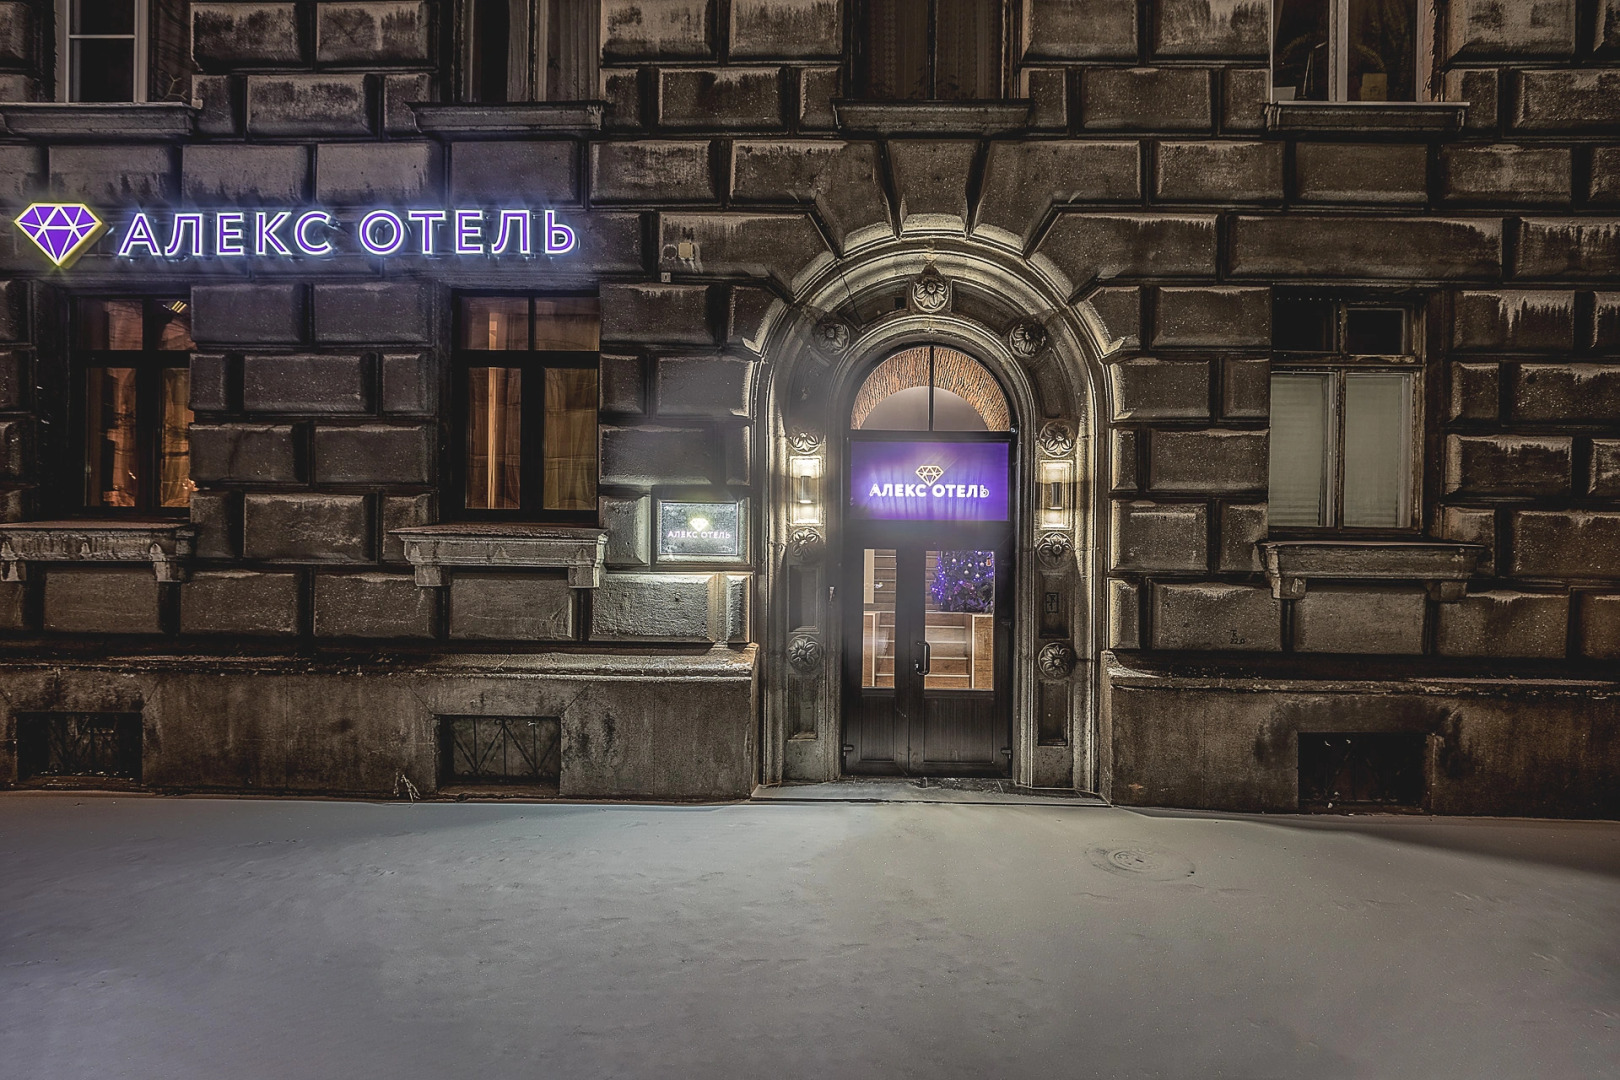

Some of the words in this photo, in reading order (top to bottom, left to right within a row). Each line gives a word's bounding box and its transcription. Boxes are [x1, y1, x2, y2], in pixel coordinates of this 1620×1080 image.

[118, 210, 333, 256] АЛЕКС
[359, 209, 576, 255] ОТЕЛЬ
[869, 483, 927, 498] АЛЕКС
[932, 484, 990, 499] ОТЕЛЬ
[667, 530, 698, 539] АЛЕКС
[700, 530, 731, 540] ОТЕЛЬ
